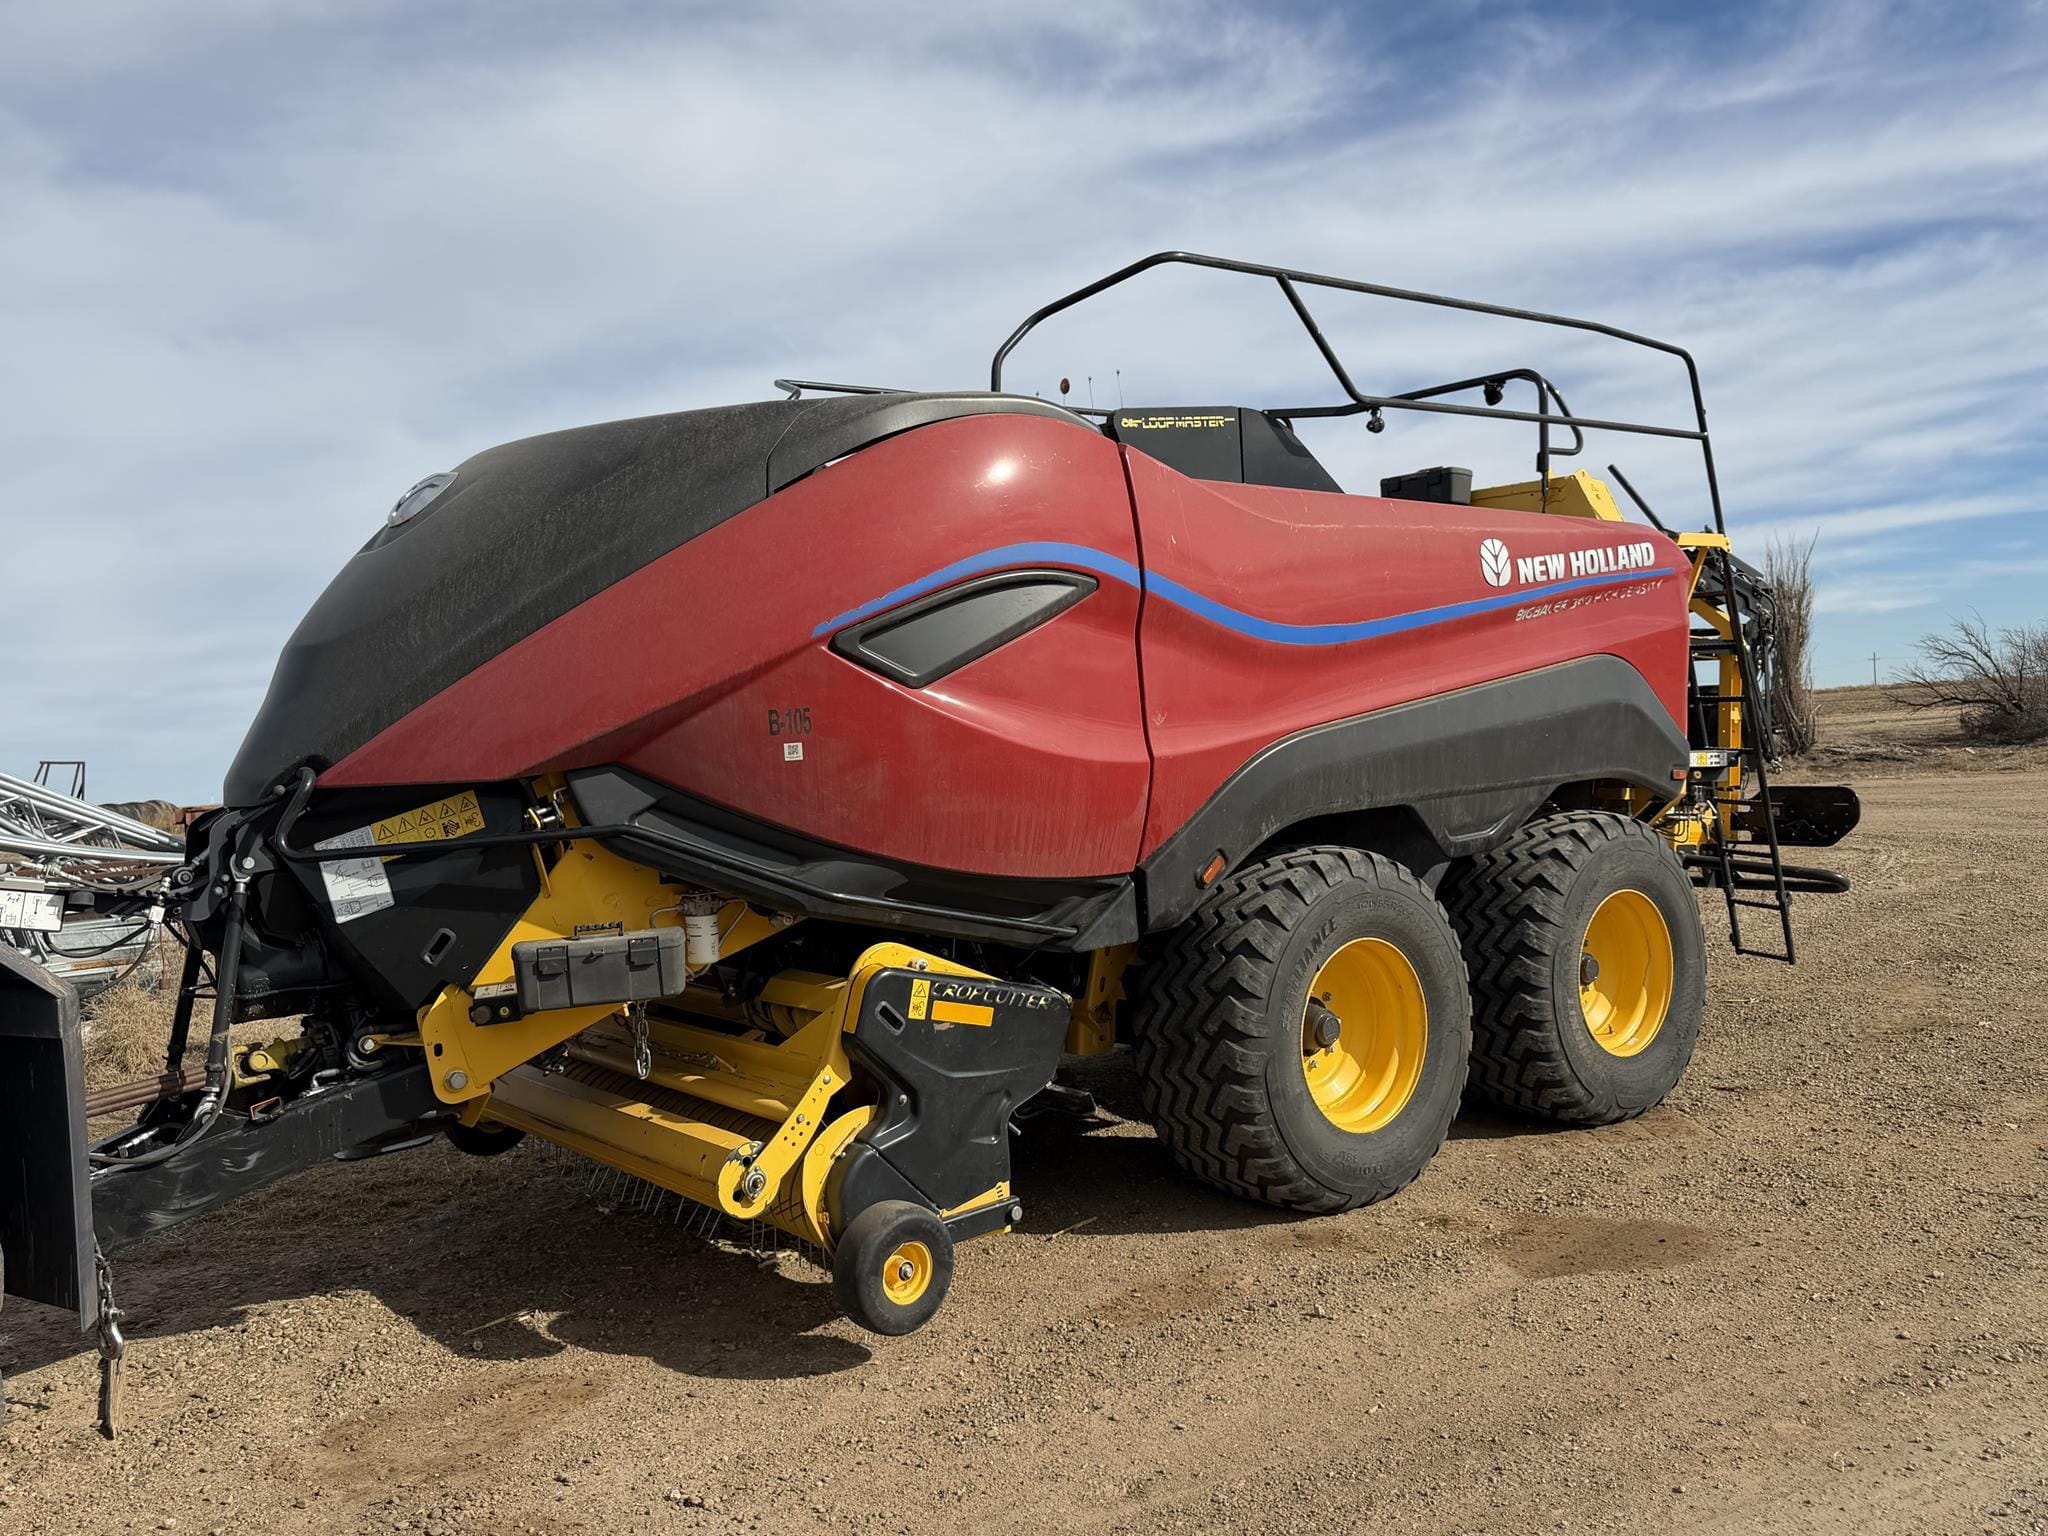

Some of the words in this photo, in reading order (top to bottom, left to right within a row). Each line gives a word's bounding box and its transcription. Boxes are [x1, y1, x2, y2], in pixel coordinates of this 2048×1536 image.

[1517, 553, 1565, 584] NEW
[1569, 542, 1655, 577] HOLLAND
[768, 707, 812, 736] B-105
[932, 981, 1052, 1011] CROPCUTTER
